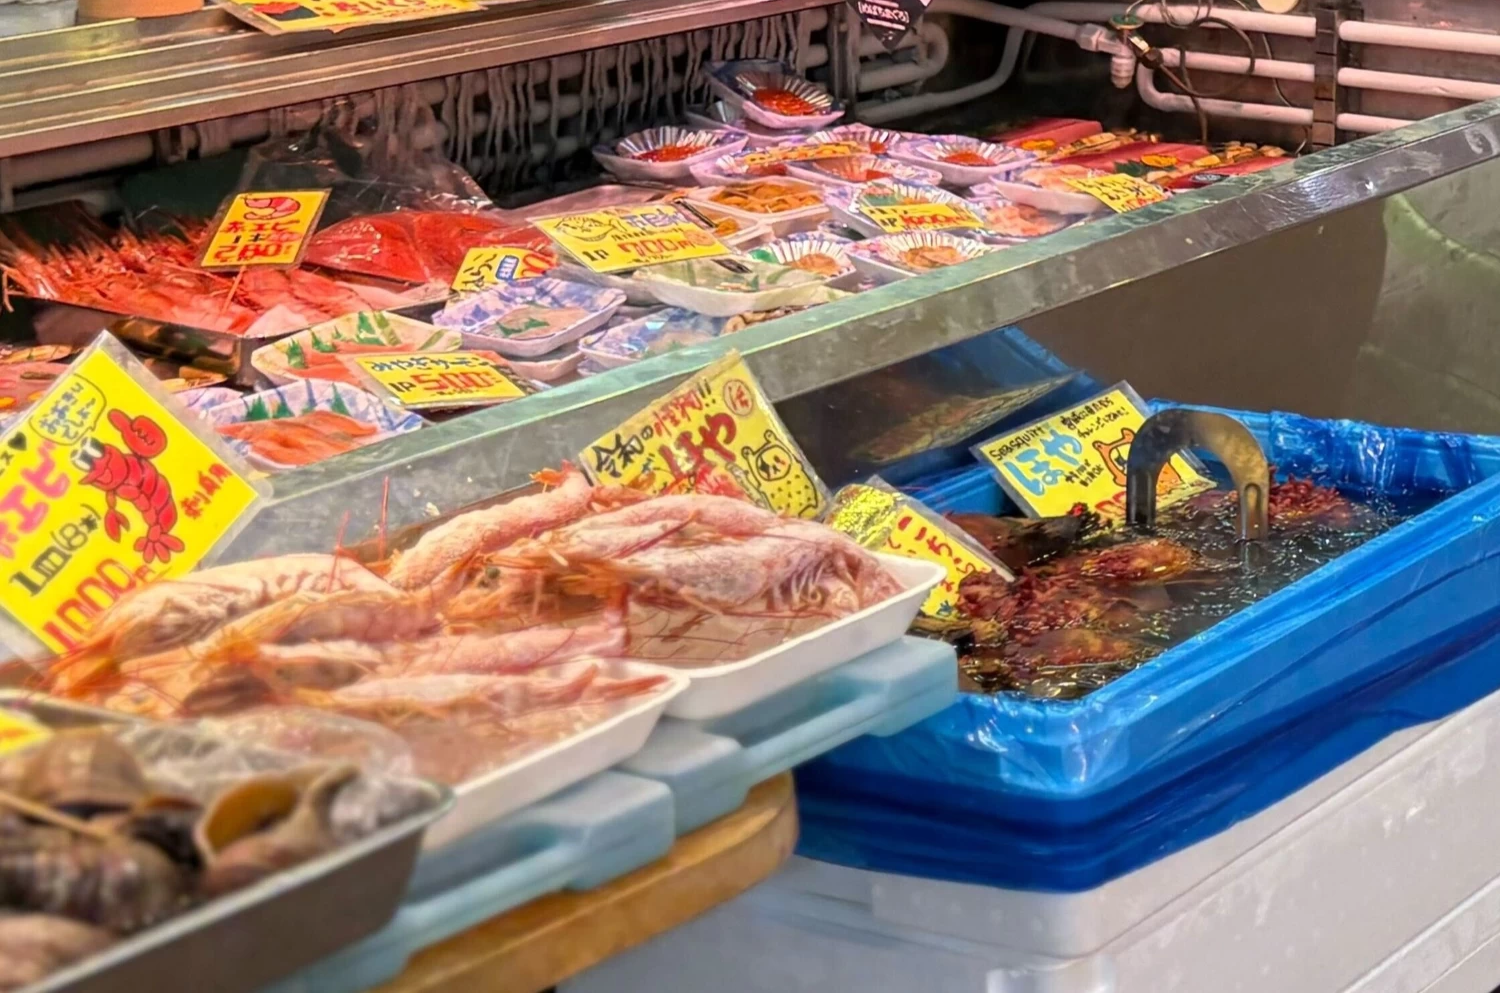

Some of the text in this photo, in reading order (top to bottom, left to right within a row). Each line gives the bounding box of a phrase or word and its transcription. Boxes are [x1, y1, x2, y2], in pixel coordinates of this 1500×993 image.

[657, 412, 738, 479] ほや
[1002, 427, 1083, 497] ほや
[181, 462, 234, 520] 刺身用
